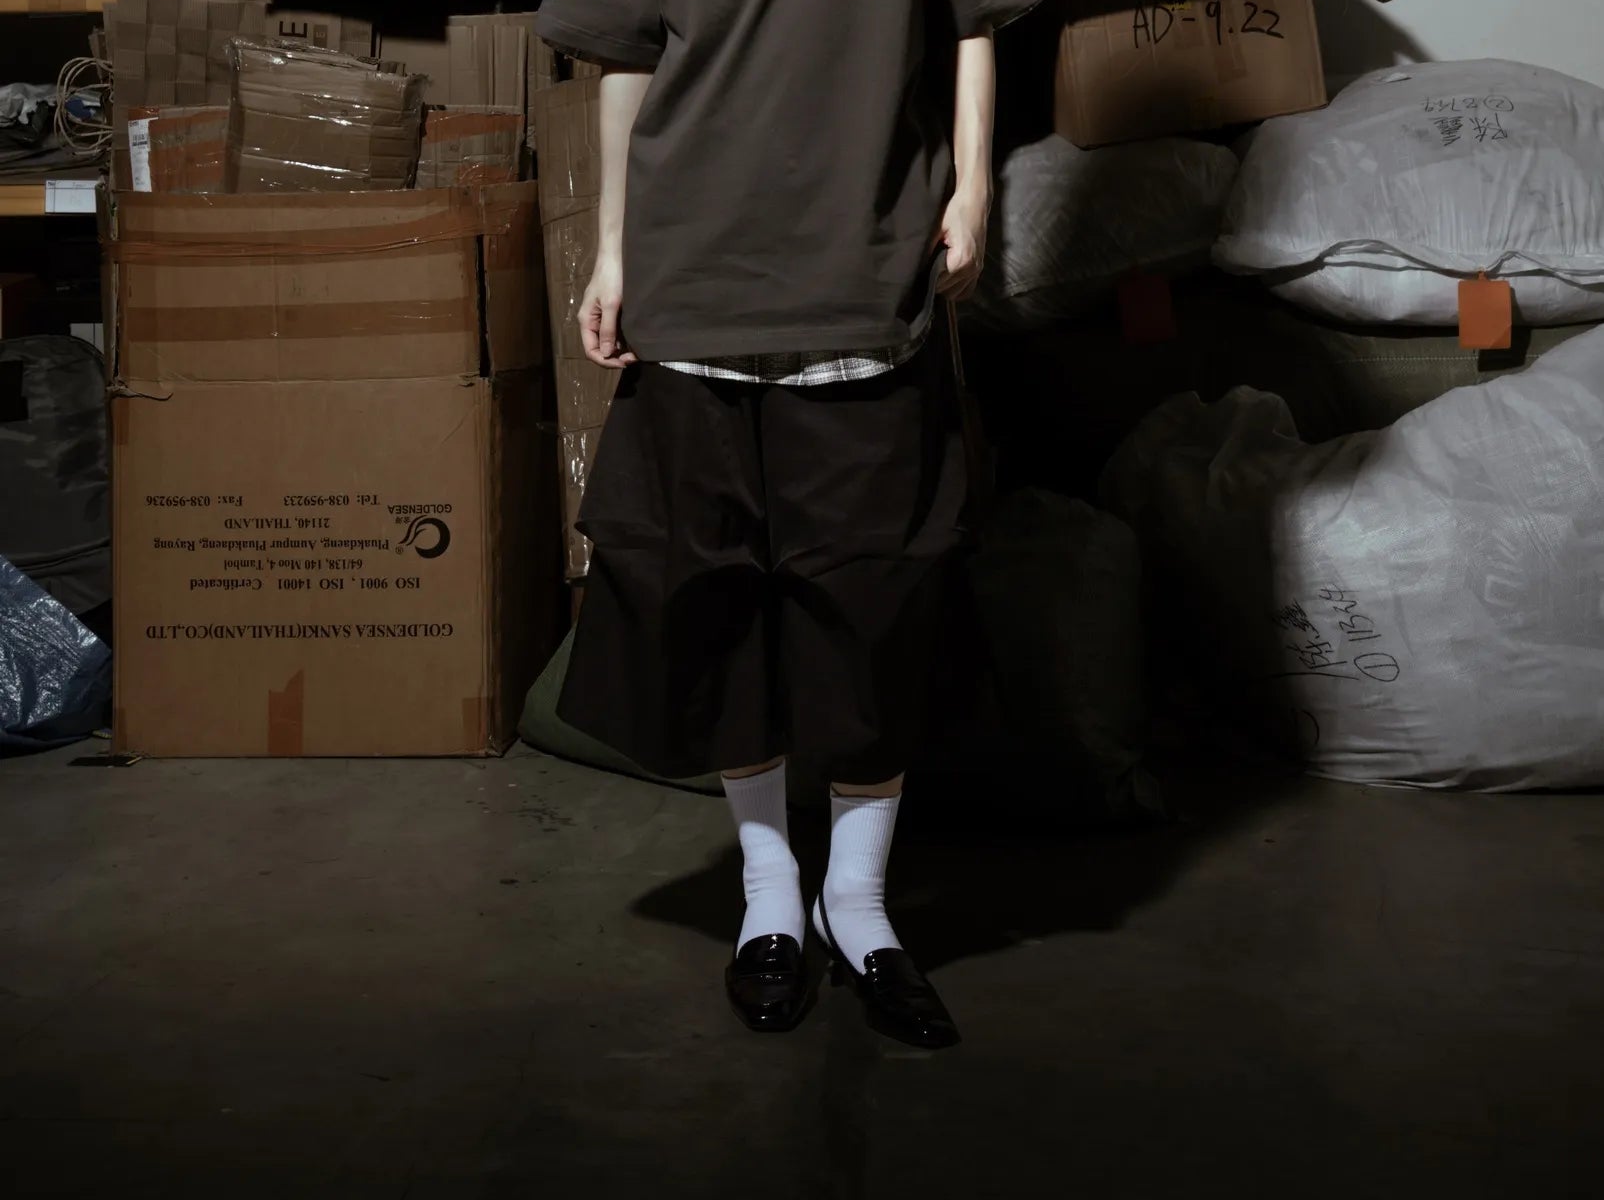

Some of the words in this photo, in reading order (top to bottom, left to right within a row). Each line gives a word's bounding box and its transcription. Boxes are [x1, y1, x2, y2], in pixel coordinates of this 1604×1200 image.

[146, 495, 211, 507] 038-959236
[217, 495, 243, 507] Fax:
[283, 495, 350, 507] 038-959233
[357, 494, 380, 506] Tel:
[387, 503, 453, 515] GOLDENSEA
[224, 518, 292, 529] THAILAND
[294, 517, 330, 529] 21140,
[154, 537, 195, 551] Rayong
[270, 537, 317, 551] Aumpur
[224, 559, 264, 571] Tambol
[278, 559, 301, 570] Moo
[304, 559, 322, 570] 140
[190, 577, 263, 591] Certificated
[278, 578, 311, 590] 14001
[319, 578, 345, 590] ISO
[395, 577, 421, 589] ISO
[355, 623, 453, 638] GOLDENSEA
